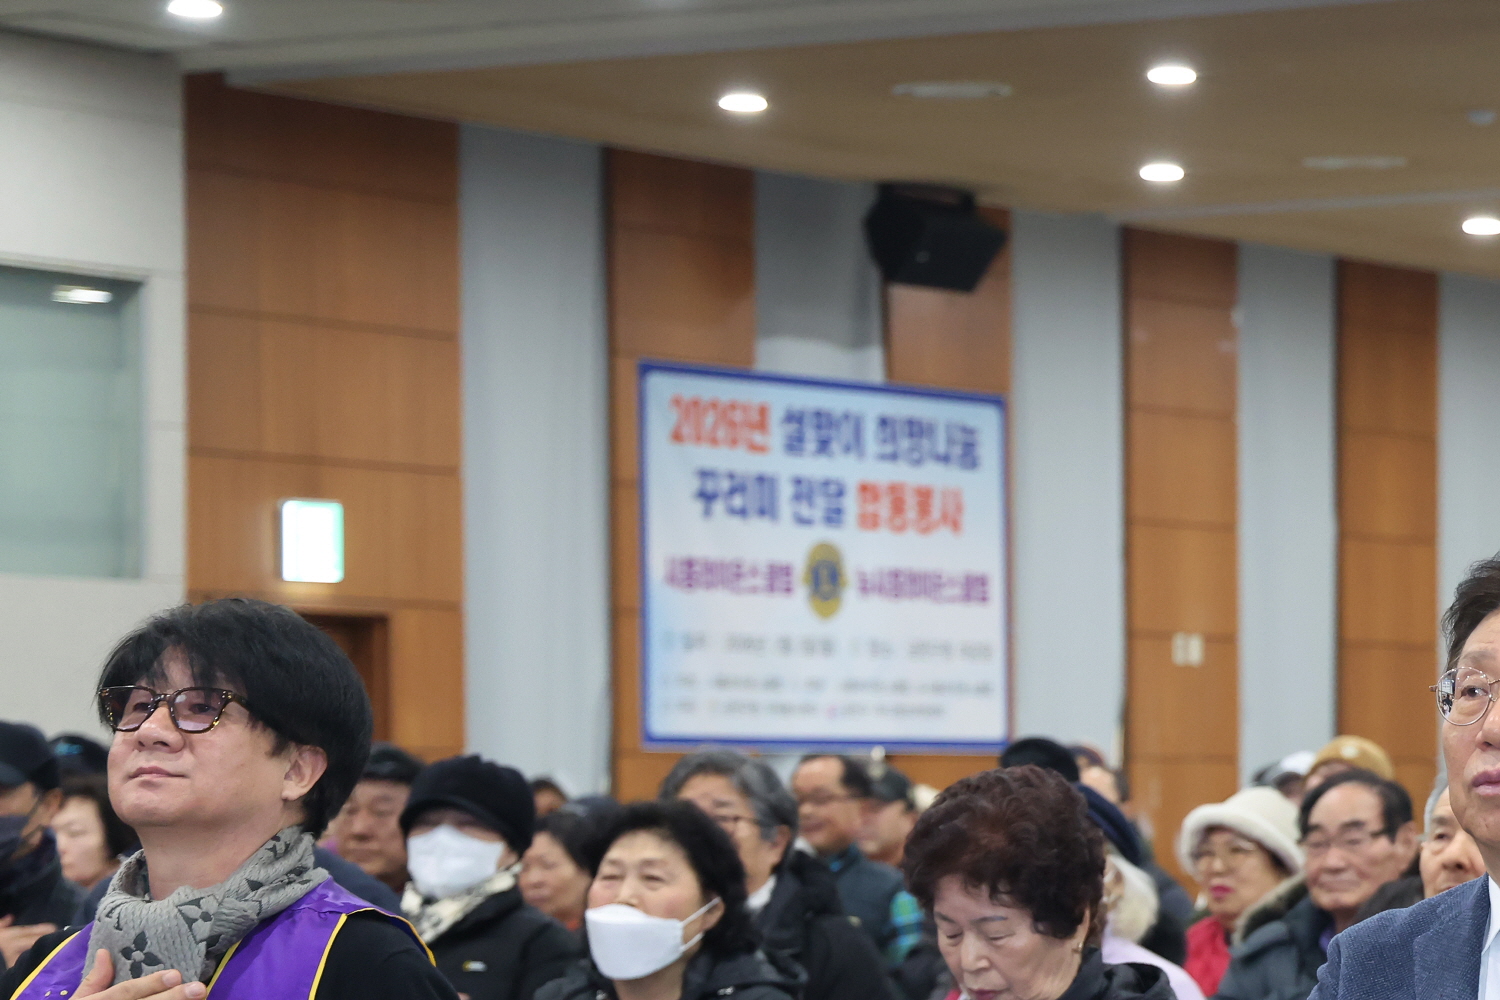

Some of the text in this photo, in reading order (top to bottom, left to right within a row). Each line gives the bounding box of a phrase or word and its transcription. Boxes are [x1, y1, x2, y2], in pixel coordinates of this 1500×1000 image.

[670, 395, 980, 471] 2026년 설맞이 희망나눔
[694, 467, 965, 536] 꾸러미 전달 합동봉사
